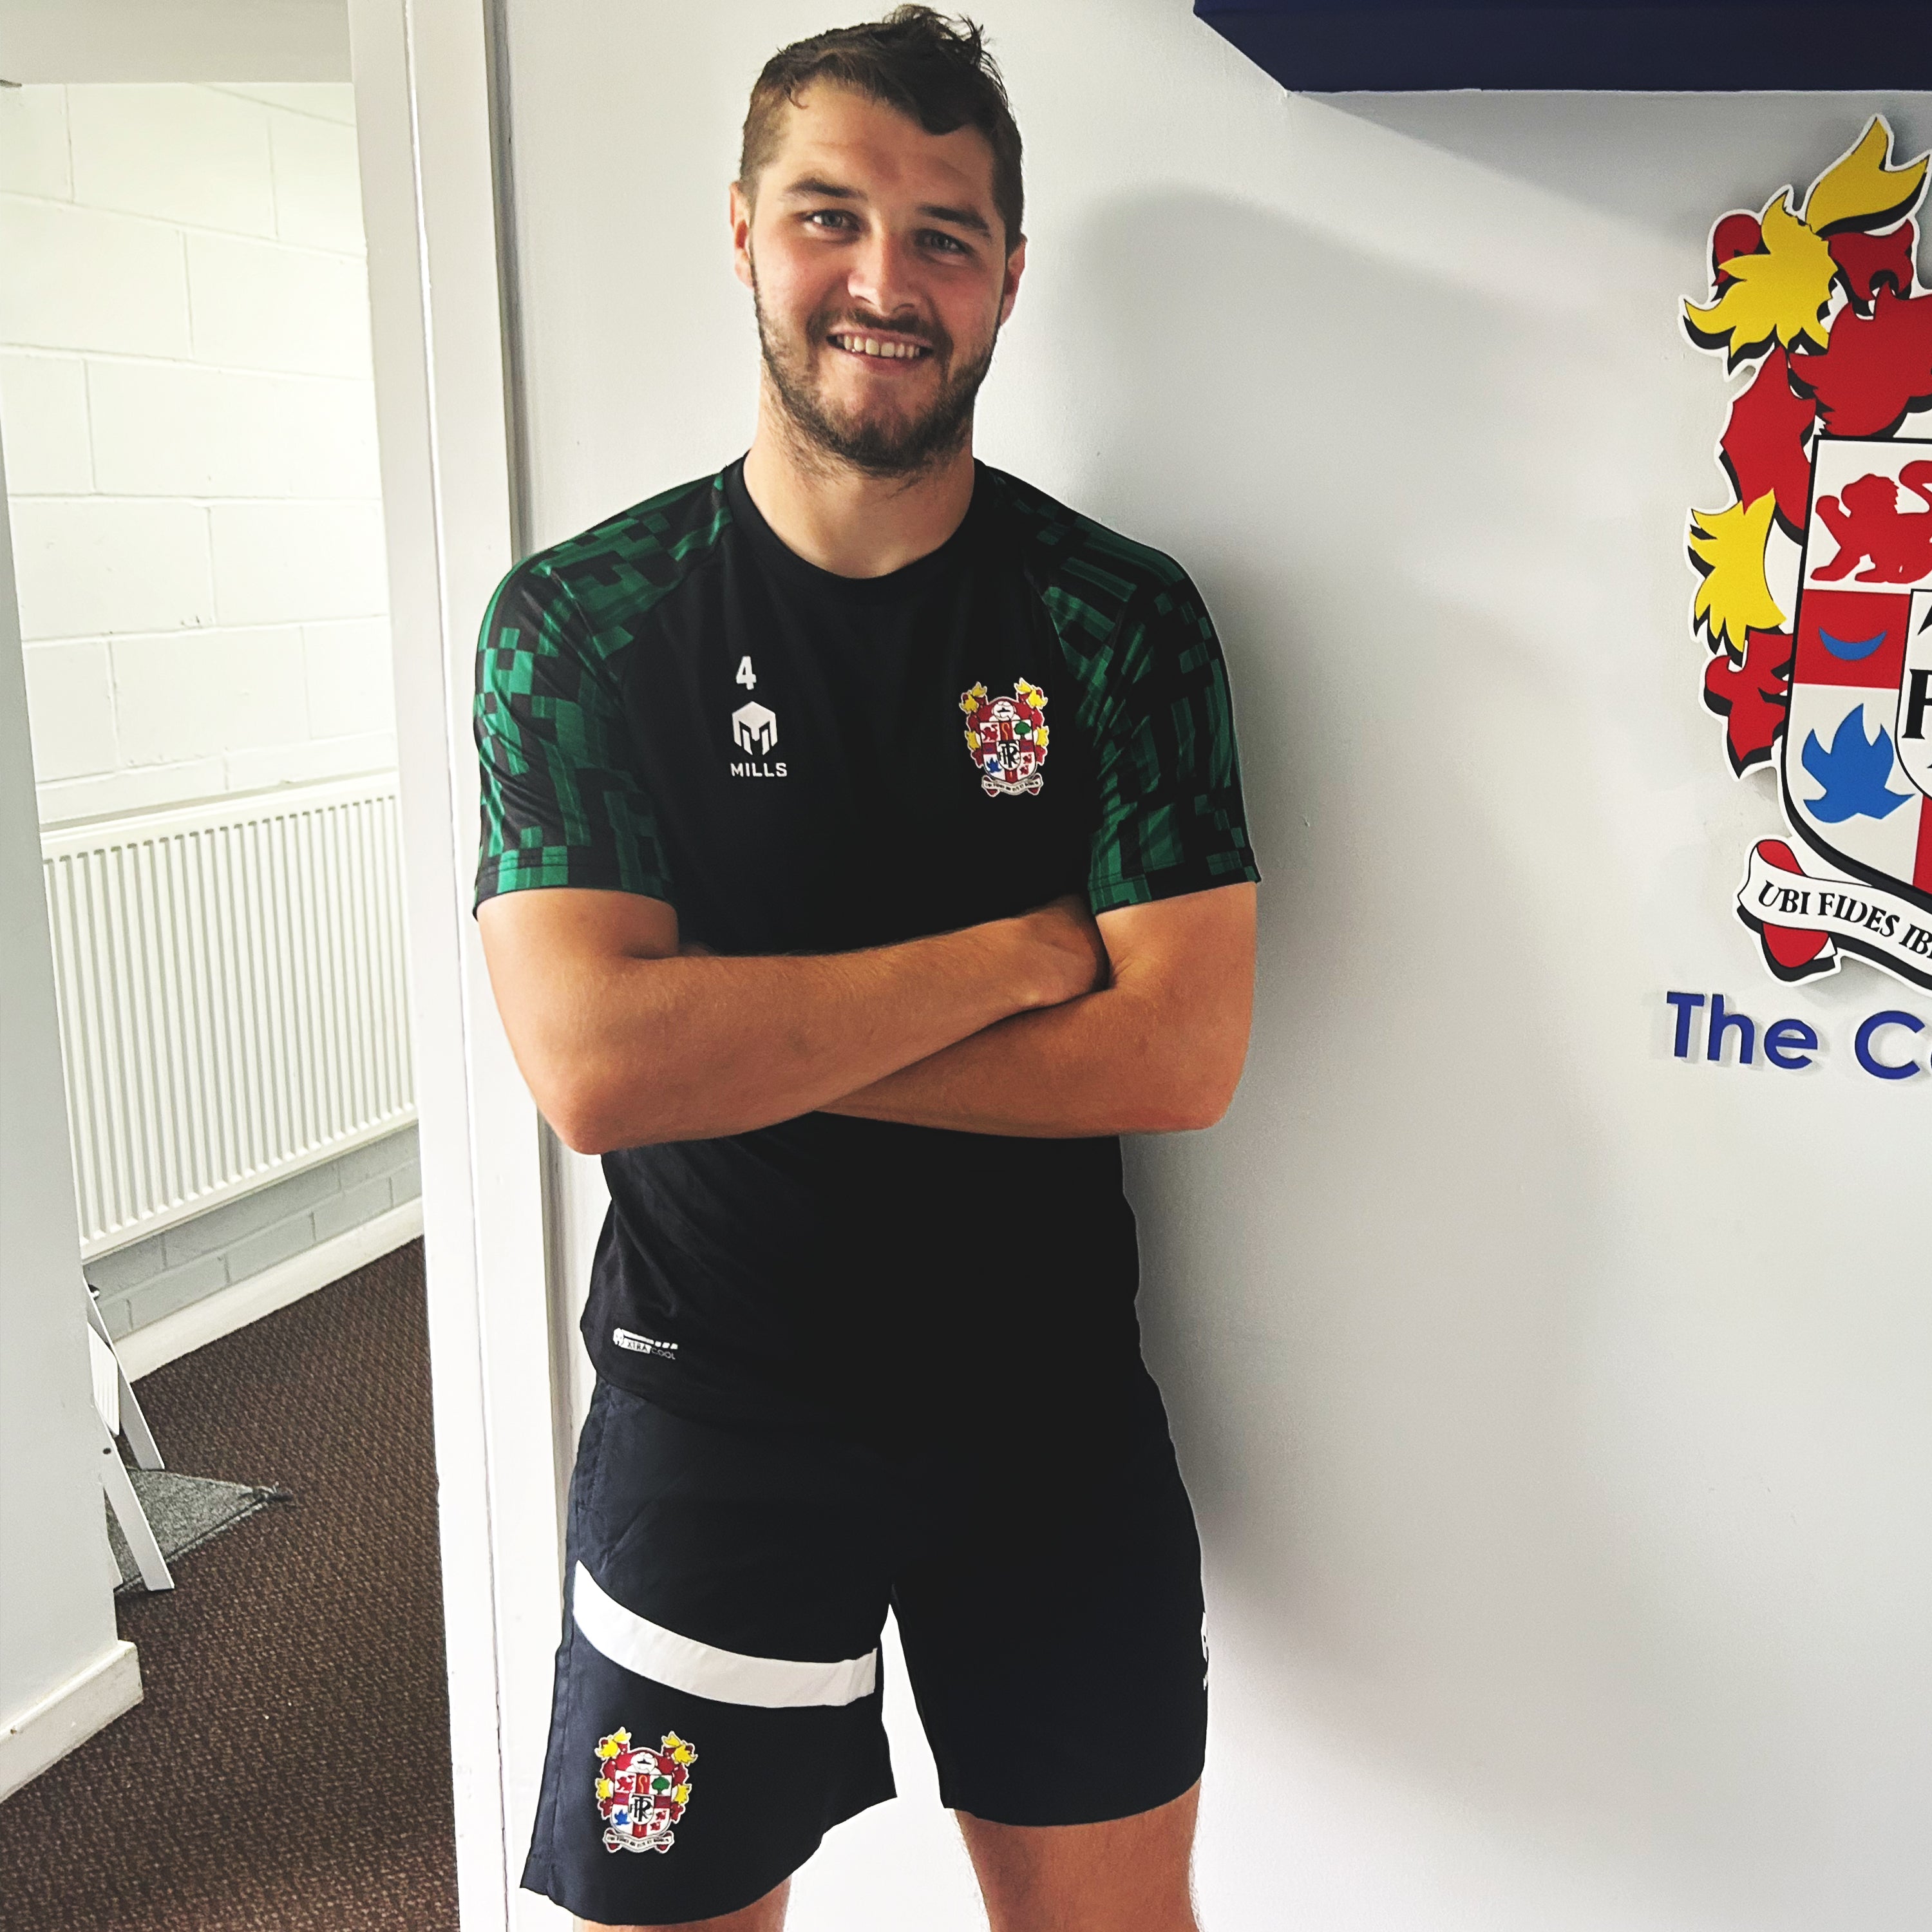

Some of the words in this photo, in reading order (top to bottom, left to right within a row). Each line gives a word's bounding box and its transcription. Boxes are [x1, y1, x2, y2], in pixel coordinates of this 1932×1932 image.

[735, 656, 757, 690] 4
[730, 762, 787, 777] MILLS
[1758, 880, 1811, 914] UBI
[1818, 893, 1900, 937] FIDES
[1667, 991, 1818, 1069] The
[1855, 1010, 1932, 1079] C
